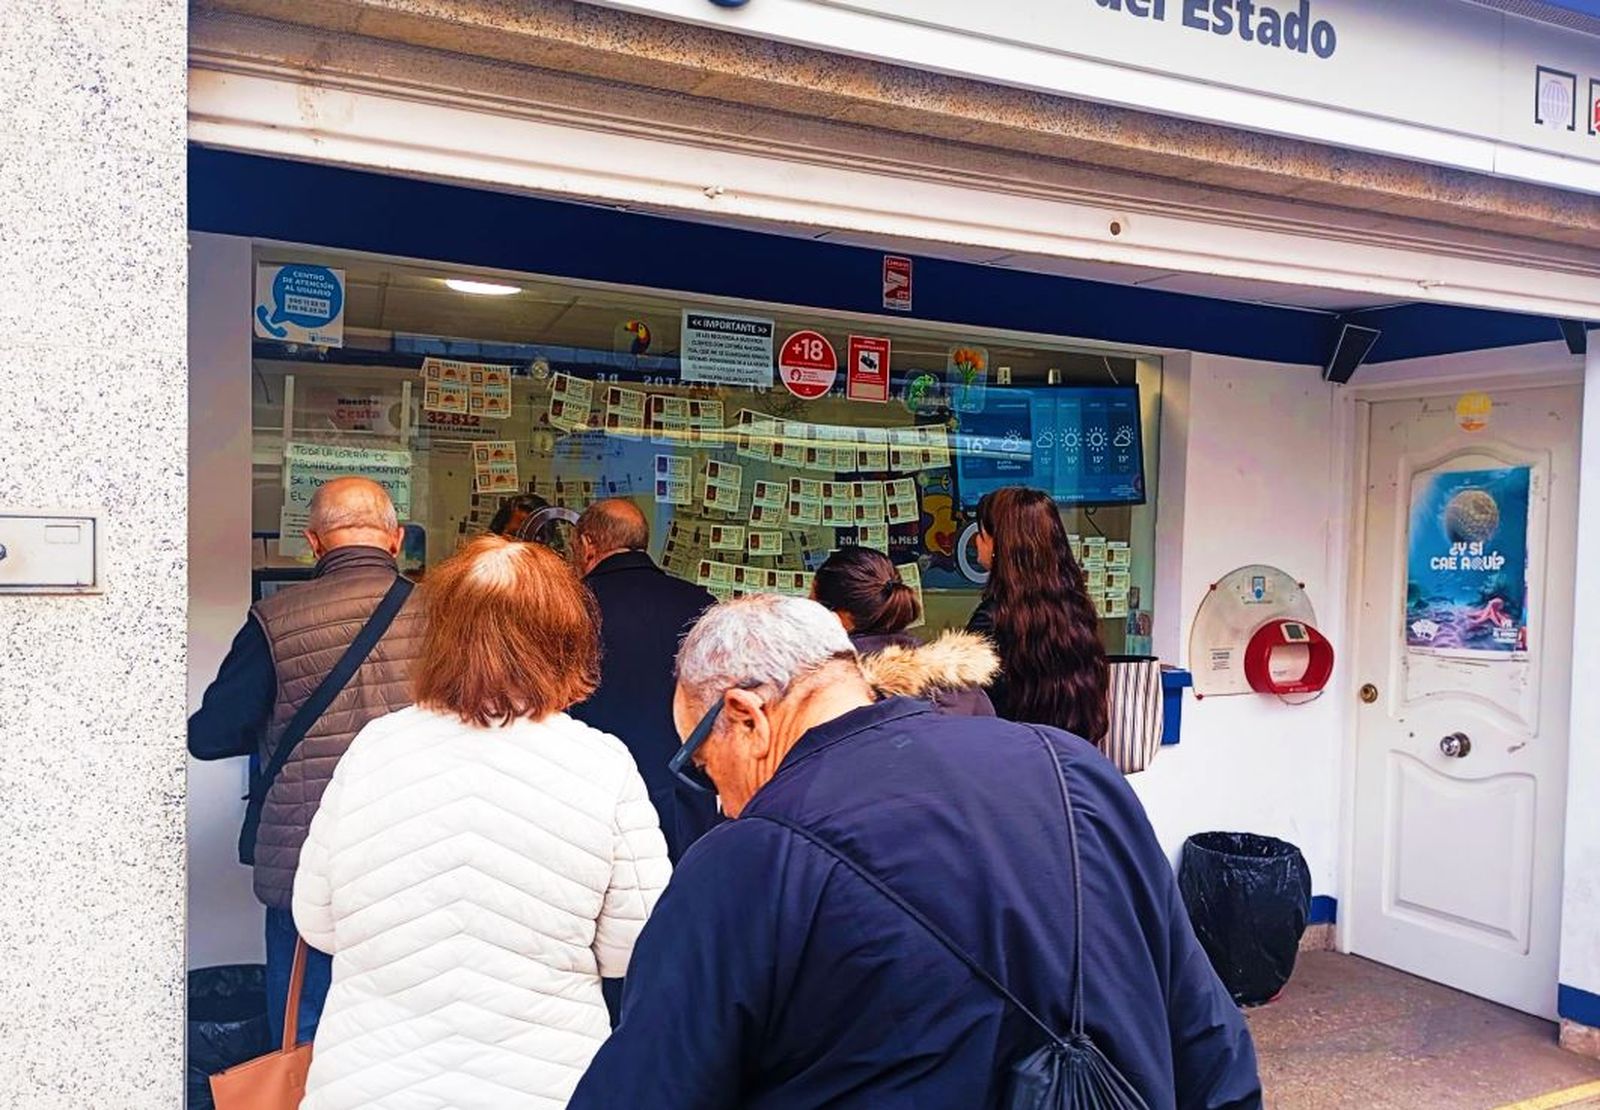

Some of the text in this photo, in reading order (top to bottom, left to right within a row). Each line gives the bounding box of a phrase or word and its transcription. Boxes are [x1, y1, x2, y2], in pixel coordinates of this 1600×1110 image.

[292, 270, 325, 281] CENTRO
[282, 276, 335, 291] DE ATENCIÓN
[285, 284, 332, 297] AL USUARIO
[703, 319, 757, 334] IMPORTANTE
[791, 338, 824, 361] +18
[426, 411, 481, 426] 32.812
[964, 437, 991, 454] 16°
[1430, 550, 1506, 572] CAE AQUÍ?
